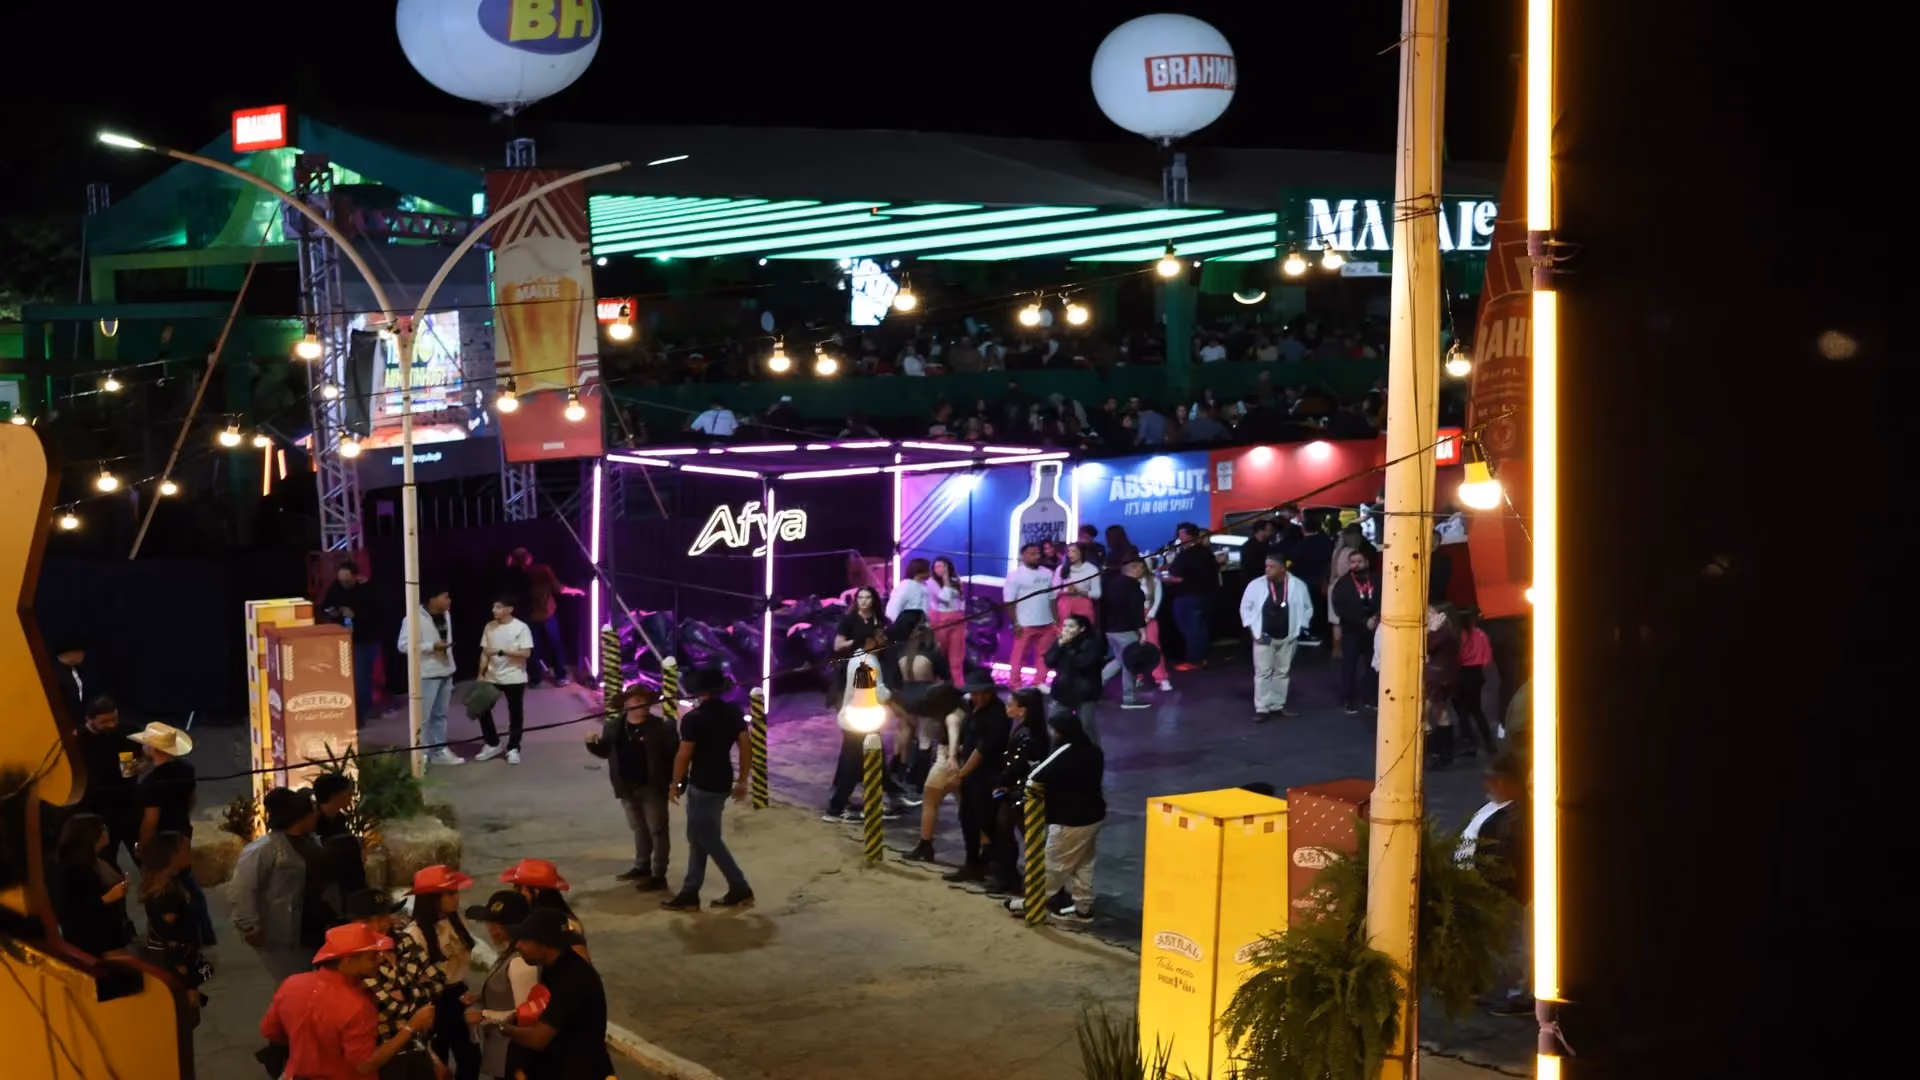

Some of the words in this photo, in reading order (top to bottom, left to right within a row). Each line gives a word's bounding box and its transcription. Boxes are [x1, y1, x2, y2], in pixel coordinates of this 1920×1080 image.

[506, 0, 593, 42] BH
[688, 501, 807, 557] Afya
[1158, 935, 1199, 960] ASTRAL
